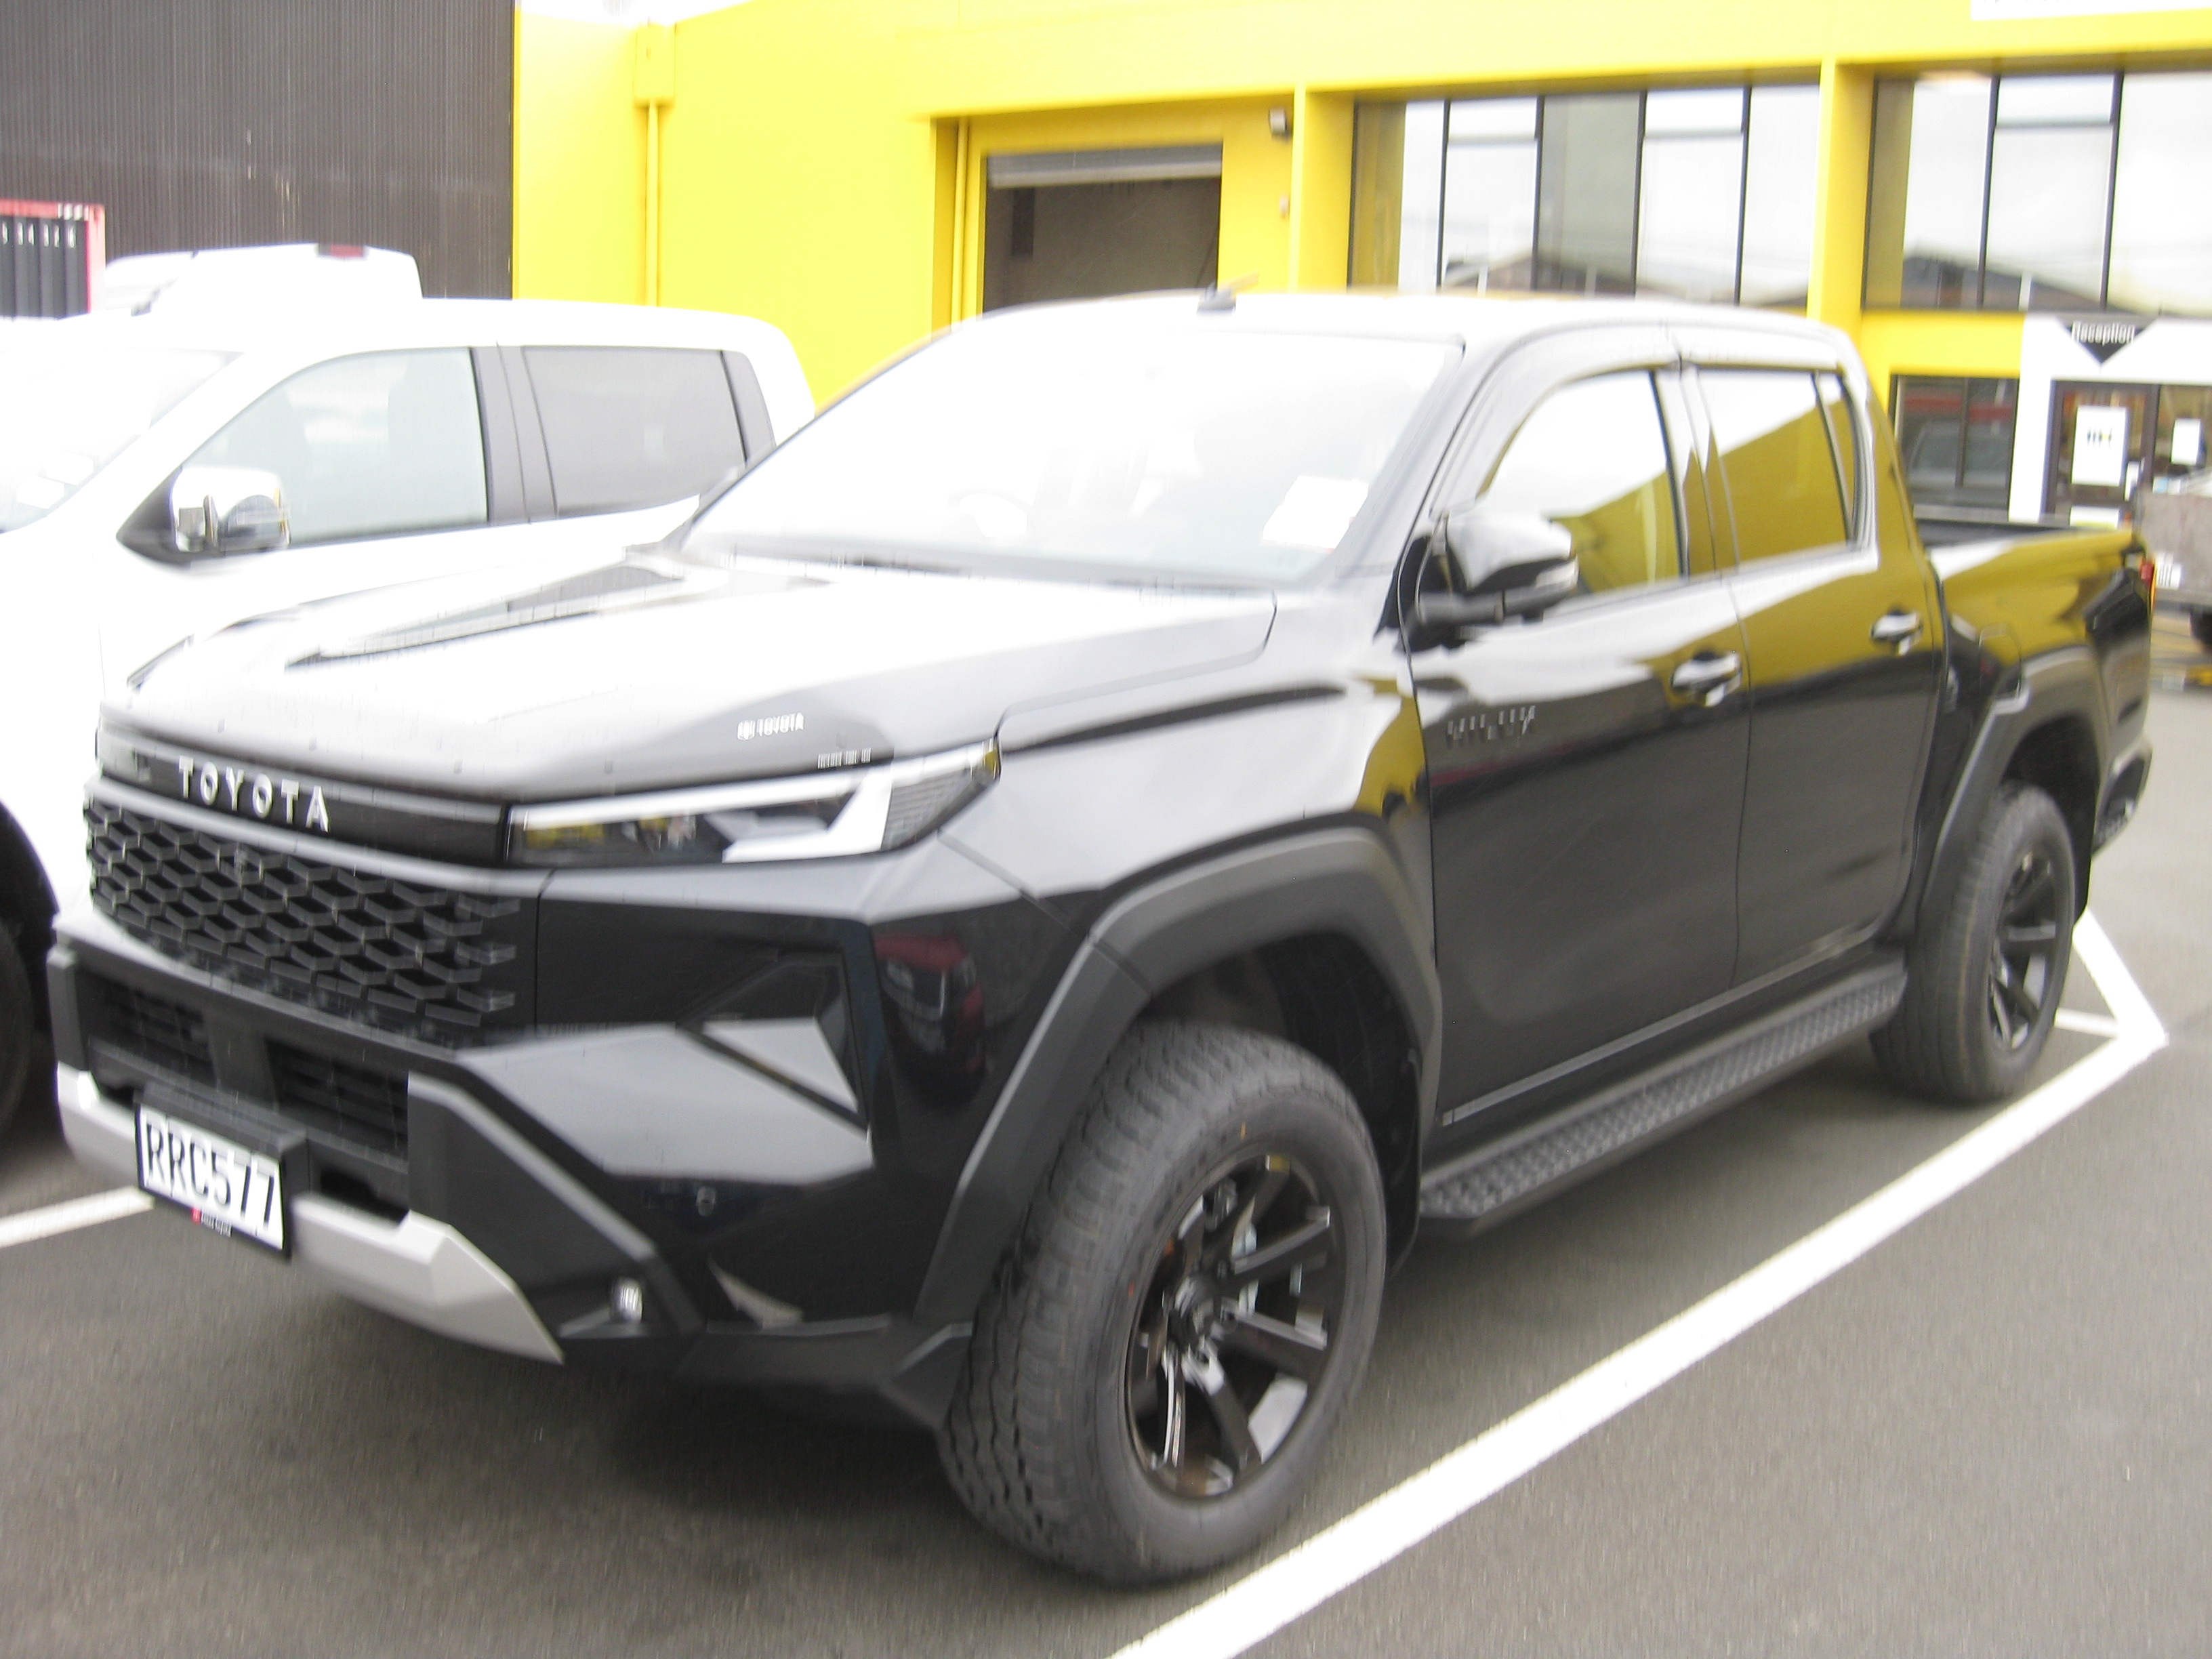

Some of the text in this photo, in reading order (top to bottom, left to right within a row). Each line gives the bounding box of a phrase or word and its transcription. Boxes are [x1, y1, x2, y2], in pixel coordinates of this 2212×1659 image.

[757, 713, 804, 737] TOYOTA
[178, 756, 330, 833] TOYOTA
[146, 1118, 275, 1230] RRC577
